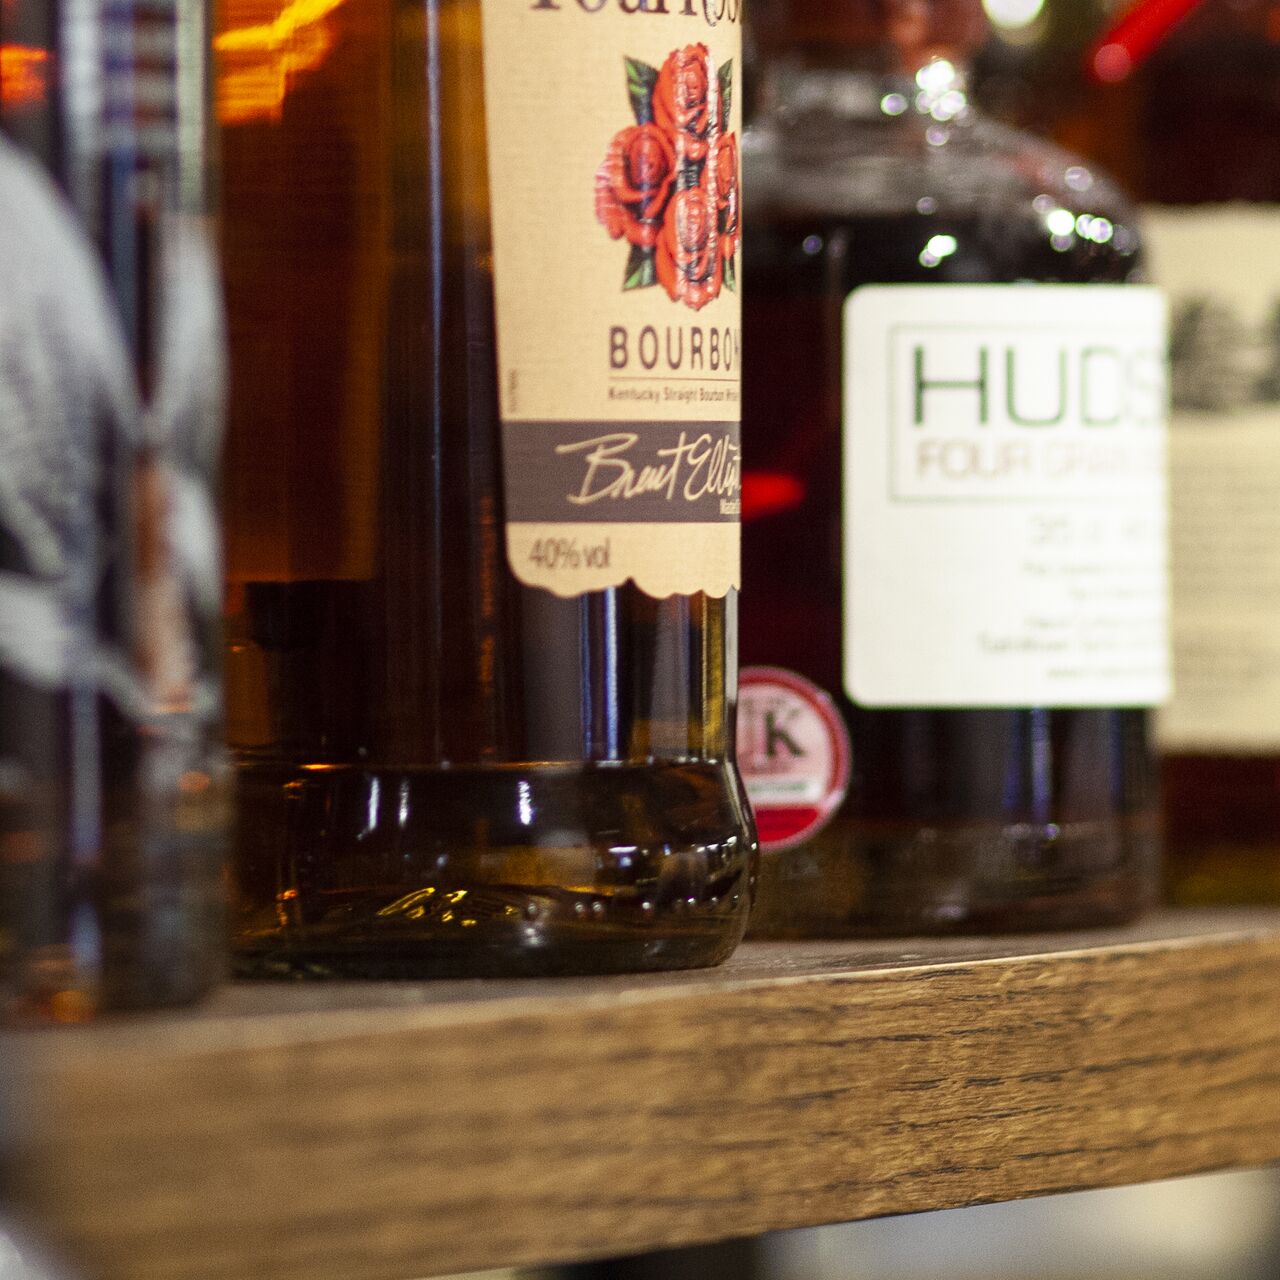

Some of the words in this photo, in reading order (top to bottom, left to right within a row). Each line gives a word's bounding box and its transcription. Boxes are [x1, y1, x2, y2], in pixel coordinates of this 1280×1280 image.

[915, 437, 1032, 482] FOUR
[528, 537, 581, 569] 40%
[582, 536, 611, 568] vol
